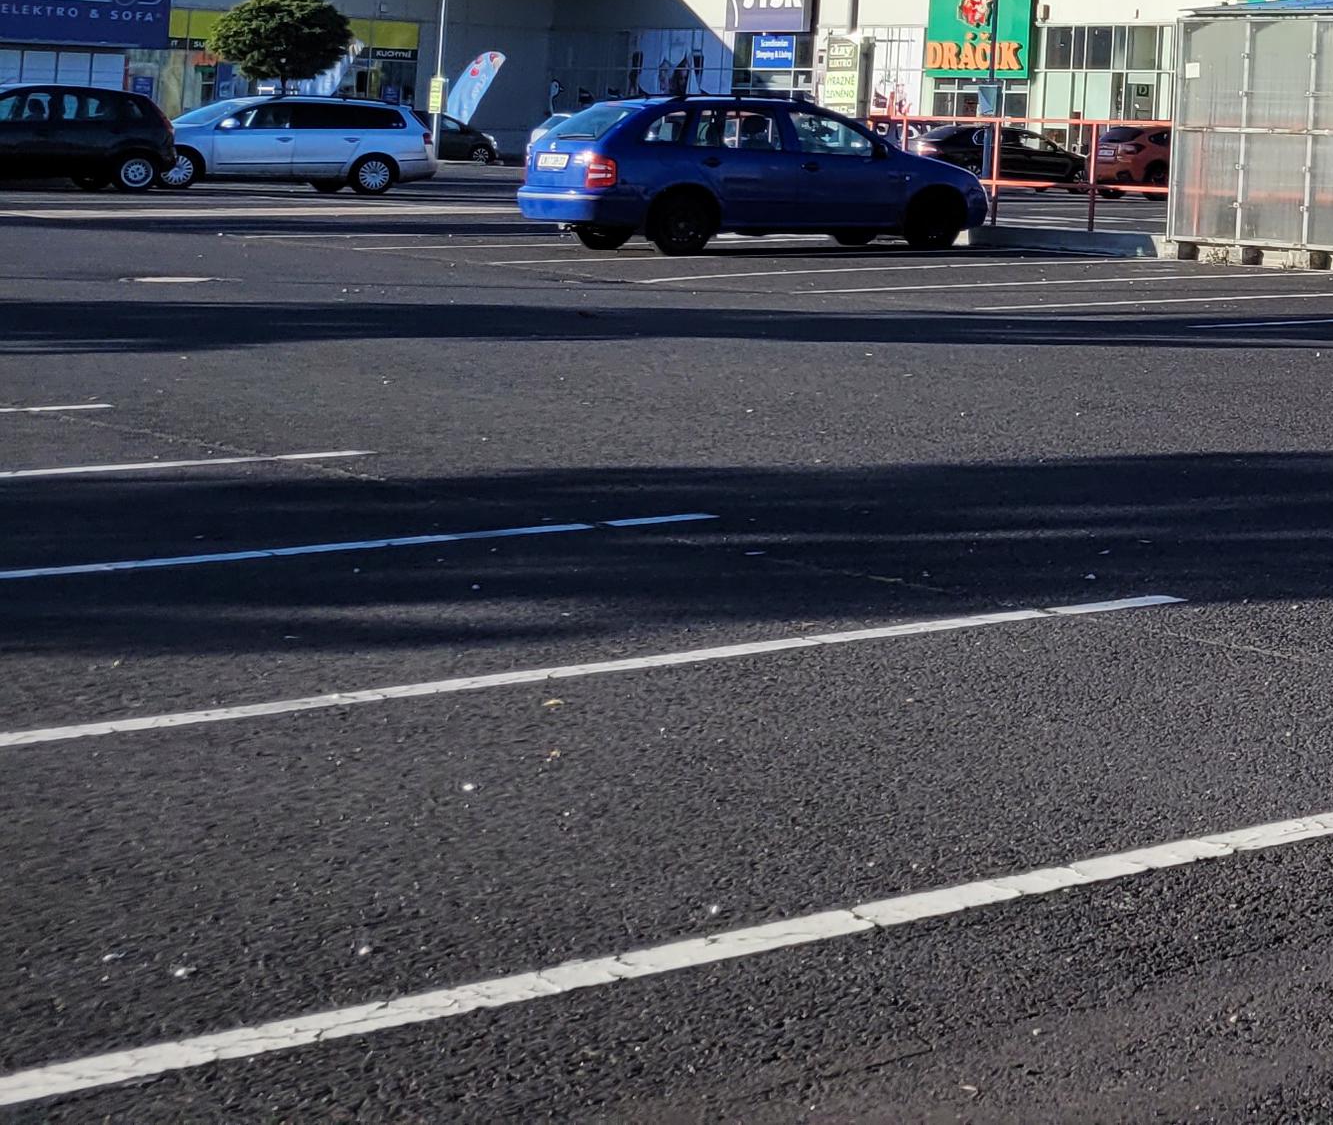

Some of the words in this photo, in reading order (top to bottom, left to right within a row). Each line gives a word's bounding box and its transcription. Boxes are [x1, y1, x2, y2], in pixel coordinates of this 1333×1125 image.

[1, 3, 78, 17] ELEKTRO
[89, 9, 99, 18] &
[110, 10, 153, 21] SOFA
